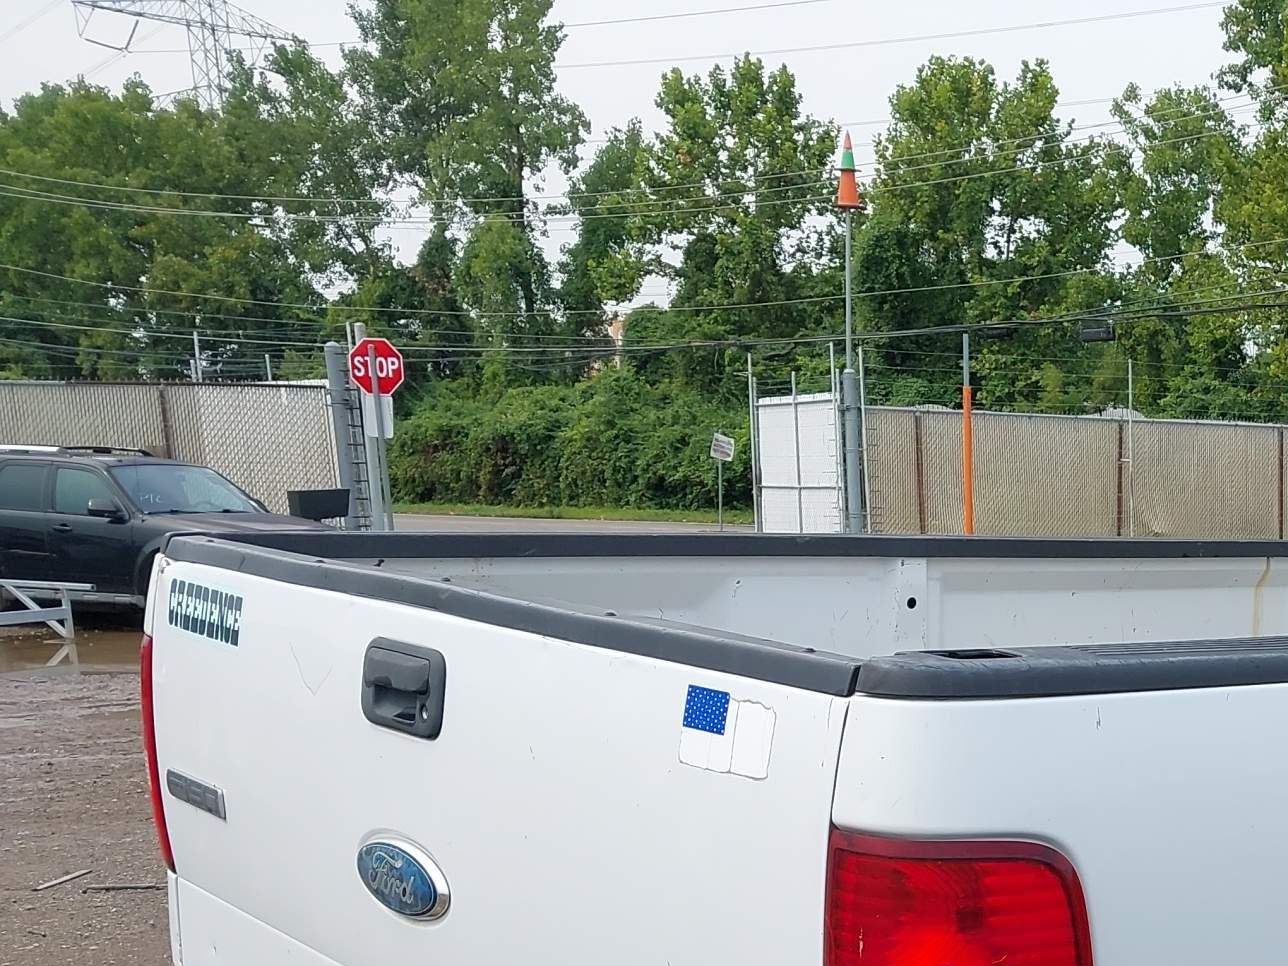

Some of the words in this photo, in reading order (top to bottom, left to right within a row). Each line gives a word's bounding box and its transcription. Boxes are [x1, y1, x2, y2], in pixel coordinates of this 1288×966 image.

[353, 356, 399, 378] STOP
[168, 578, 244, 647] CREEDENCE
[368, 851, 414, 904] Ford
